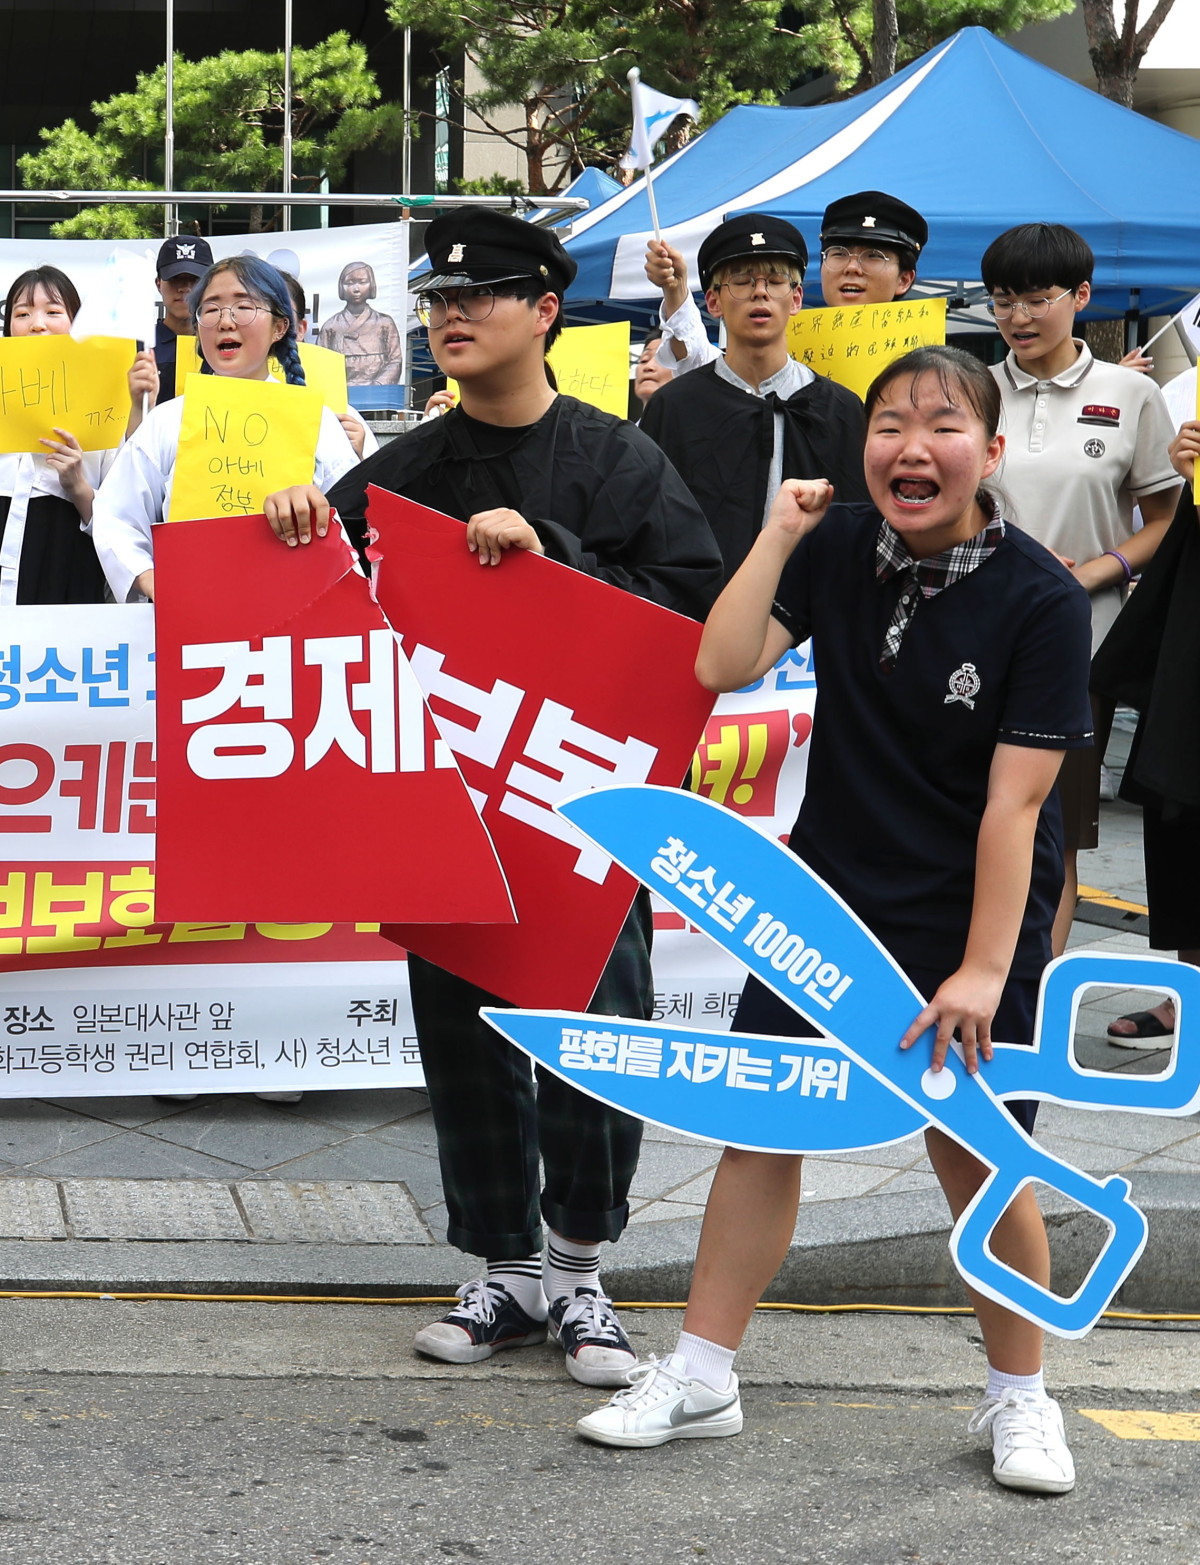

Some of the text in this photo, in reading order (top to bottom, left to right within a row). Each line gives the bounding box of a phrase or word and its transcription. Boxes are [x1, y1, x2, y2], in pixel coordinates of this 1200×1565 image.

[558, 368, 614, 397] 하다
[204, 405, 269, 447] NO
[208, 456, 265, 478] 아베
[210, 483, 256, 515] 정부
[650, 836, 854, 1012] 청소년 1000인
[3, 1001, 236, 1035] 장소 일본대사관 앞
[346, 998, 398, 1028] 주최
[124, 1041, 174, 1072] 권리
[184, 1040, 266, 1070] 연합회,
[275, 1037, 308, 1069] 사)
[316, 1036, 391, 1068] 청소년
[558, 1027, 851, 1102] 평화를 지키는 가위
